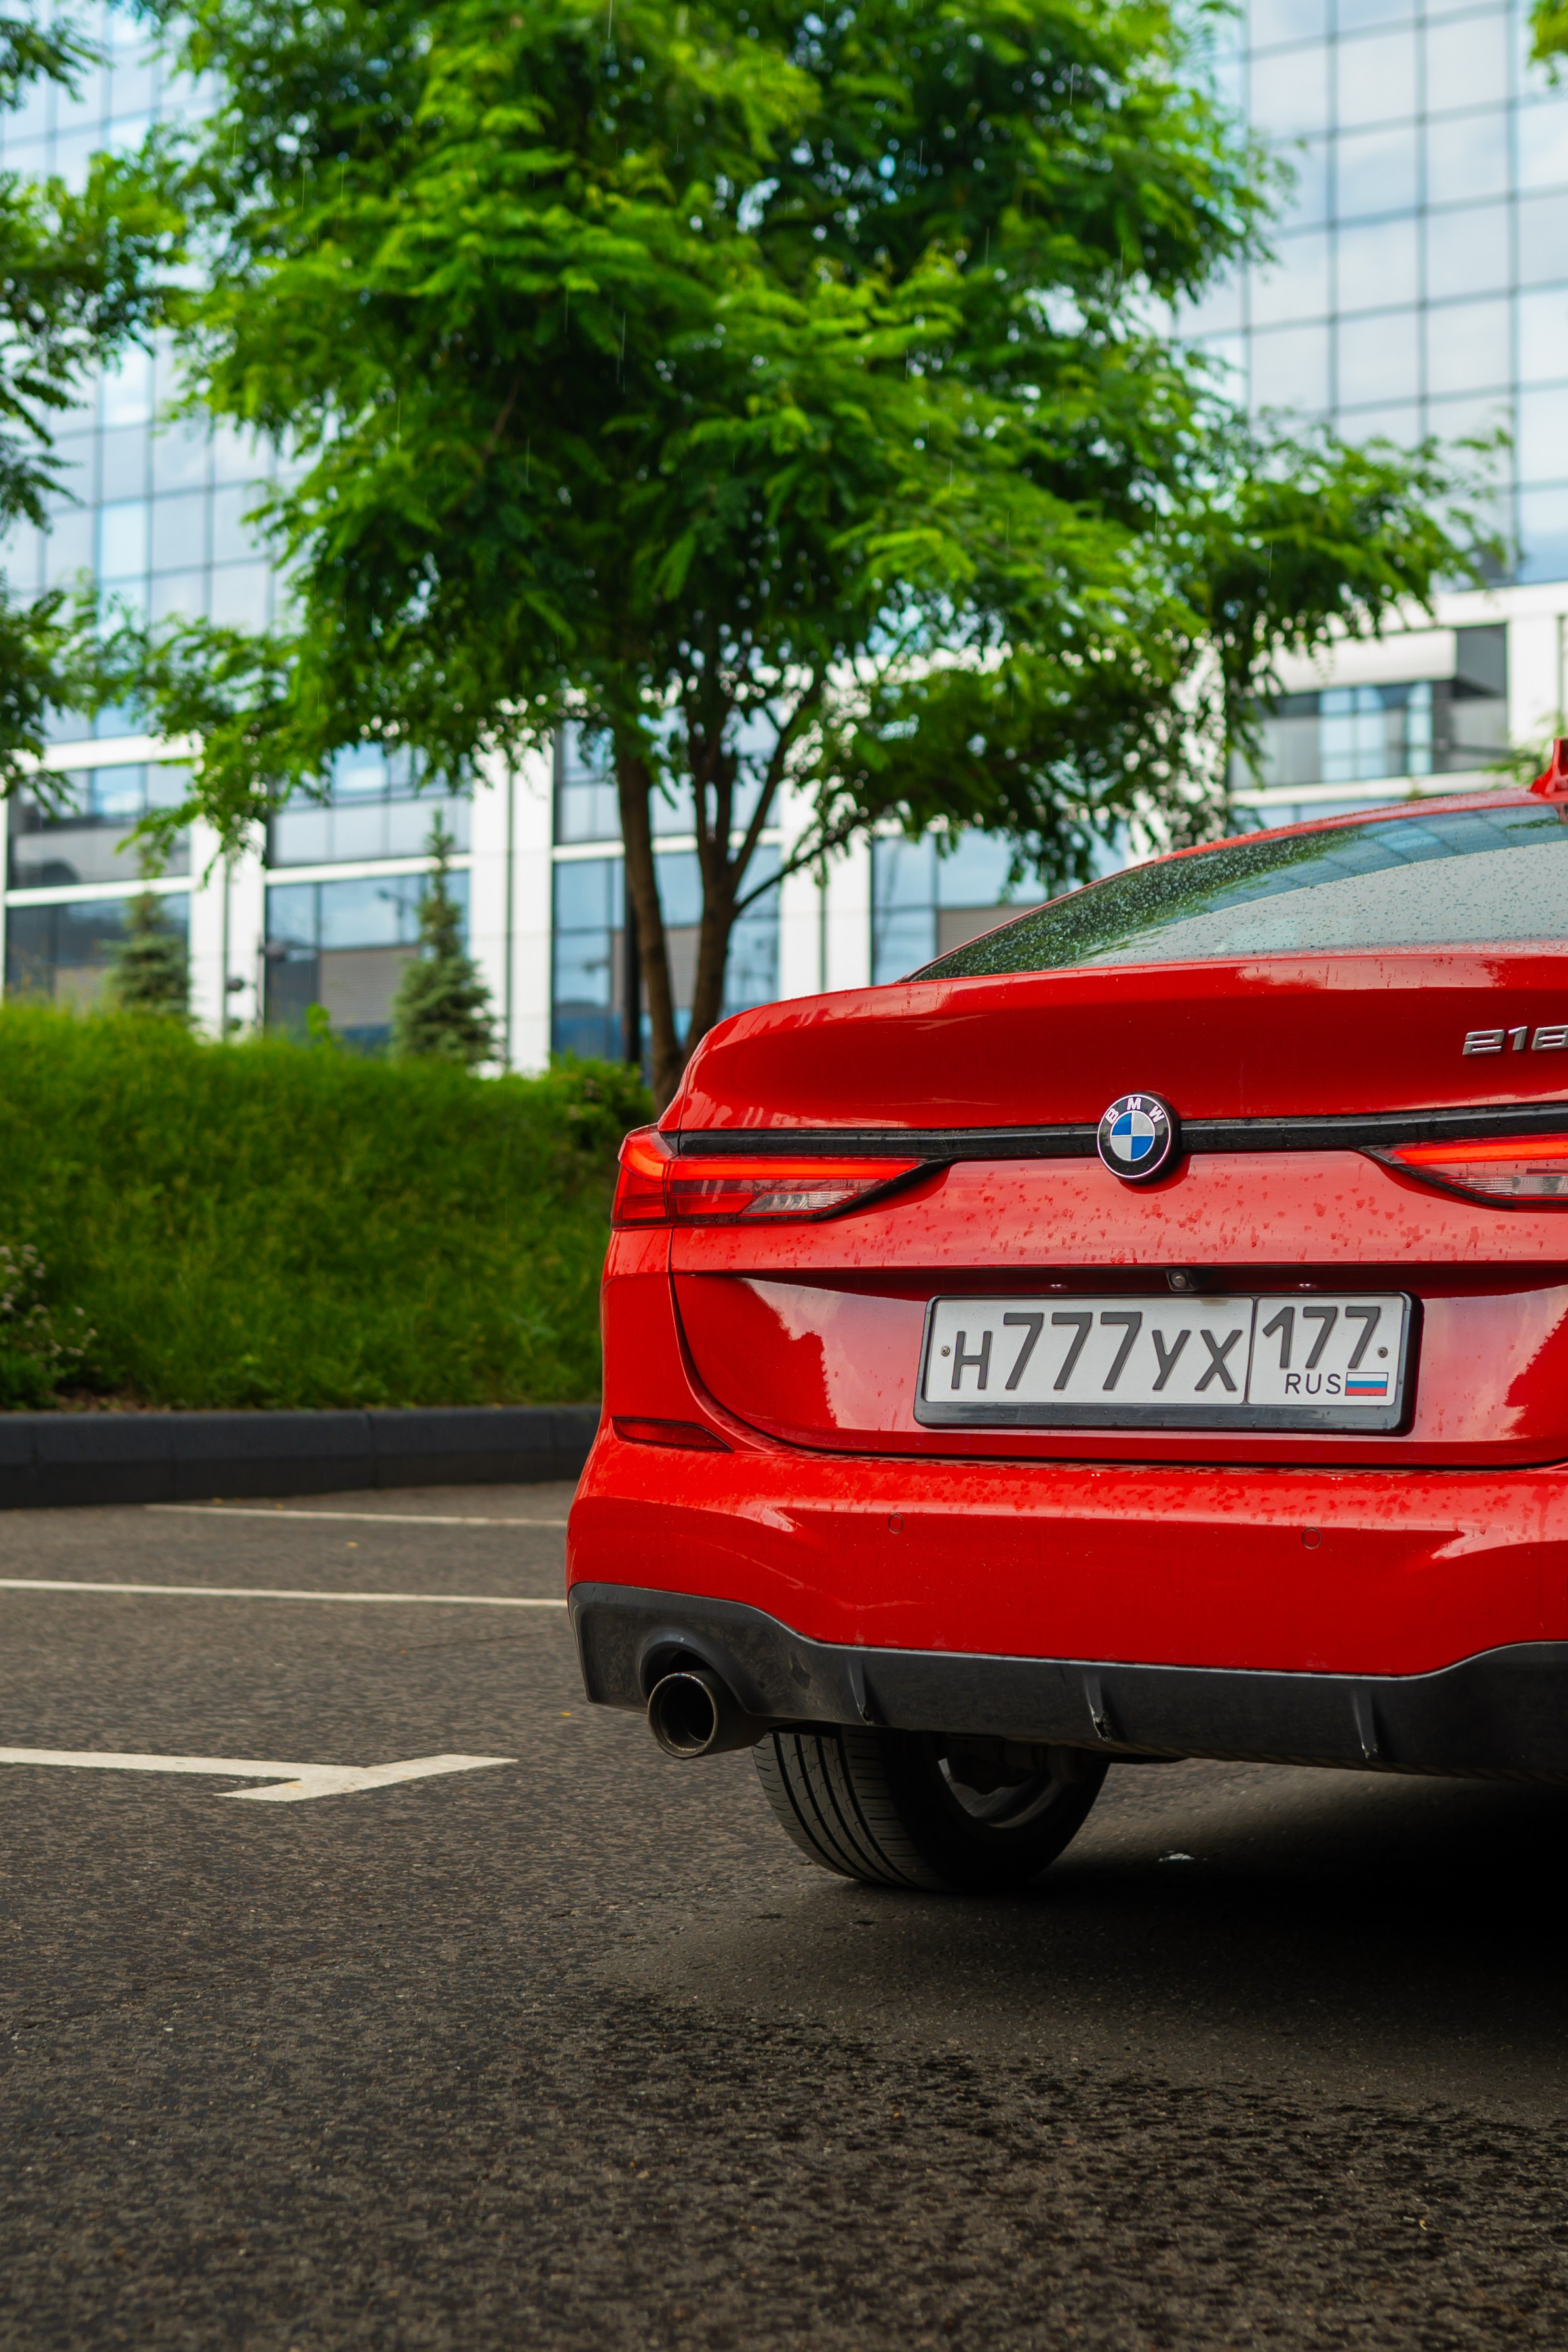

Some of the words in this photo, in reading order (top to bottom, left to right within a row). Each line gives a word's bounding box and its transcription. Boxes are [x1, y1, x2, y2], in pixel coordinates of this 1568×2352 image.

[1105, 1097, 1165, 1124] BMW
[1263, 1306, 1381, 1369] 177
[1285, 1373, 1341, 1395] RUS
